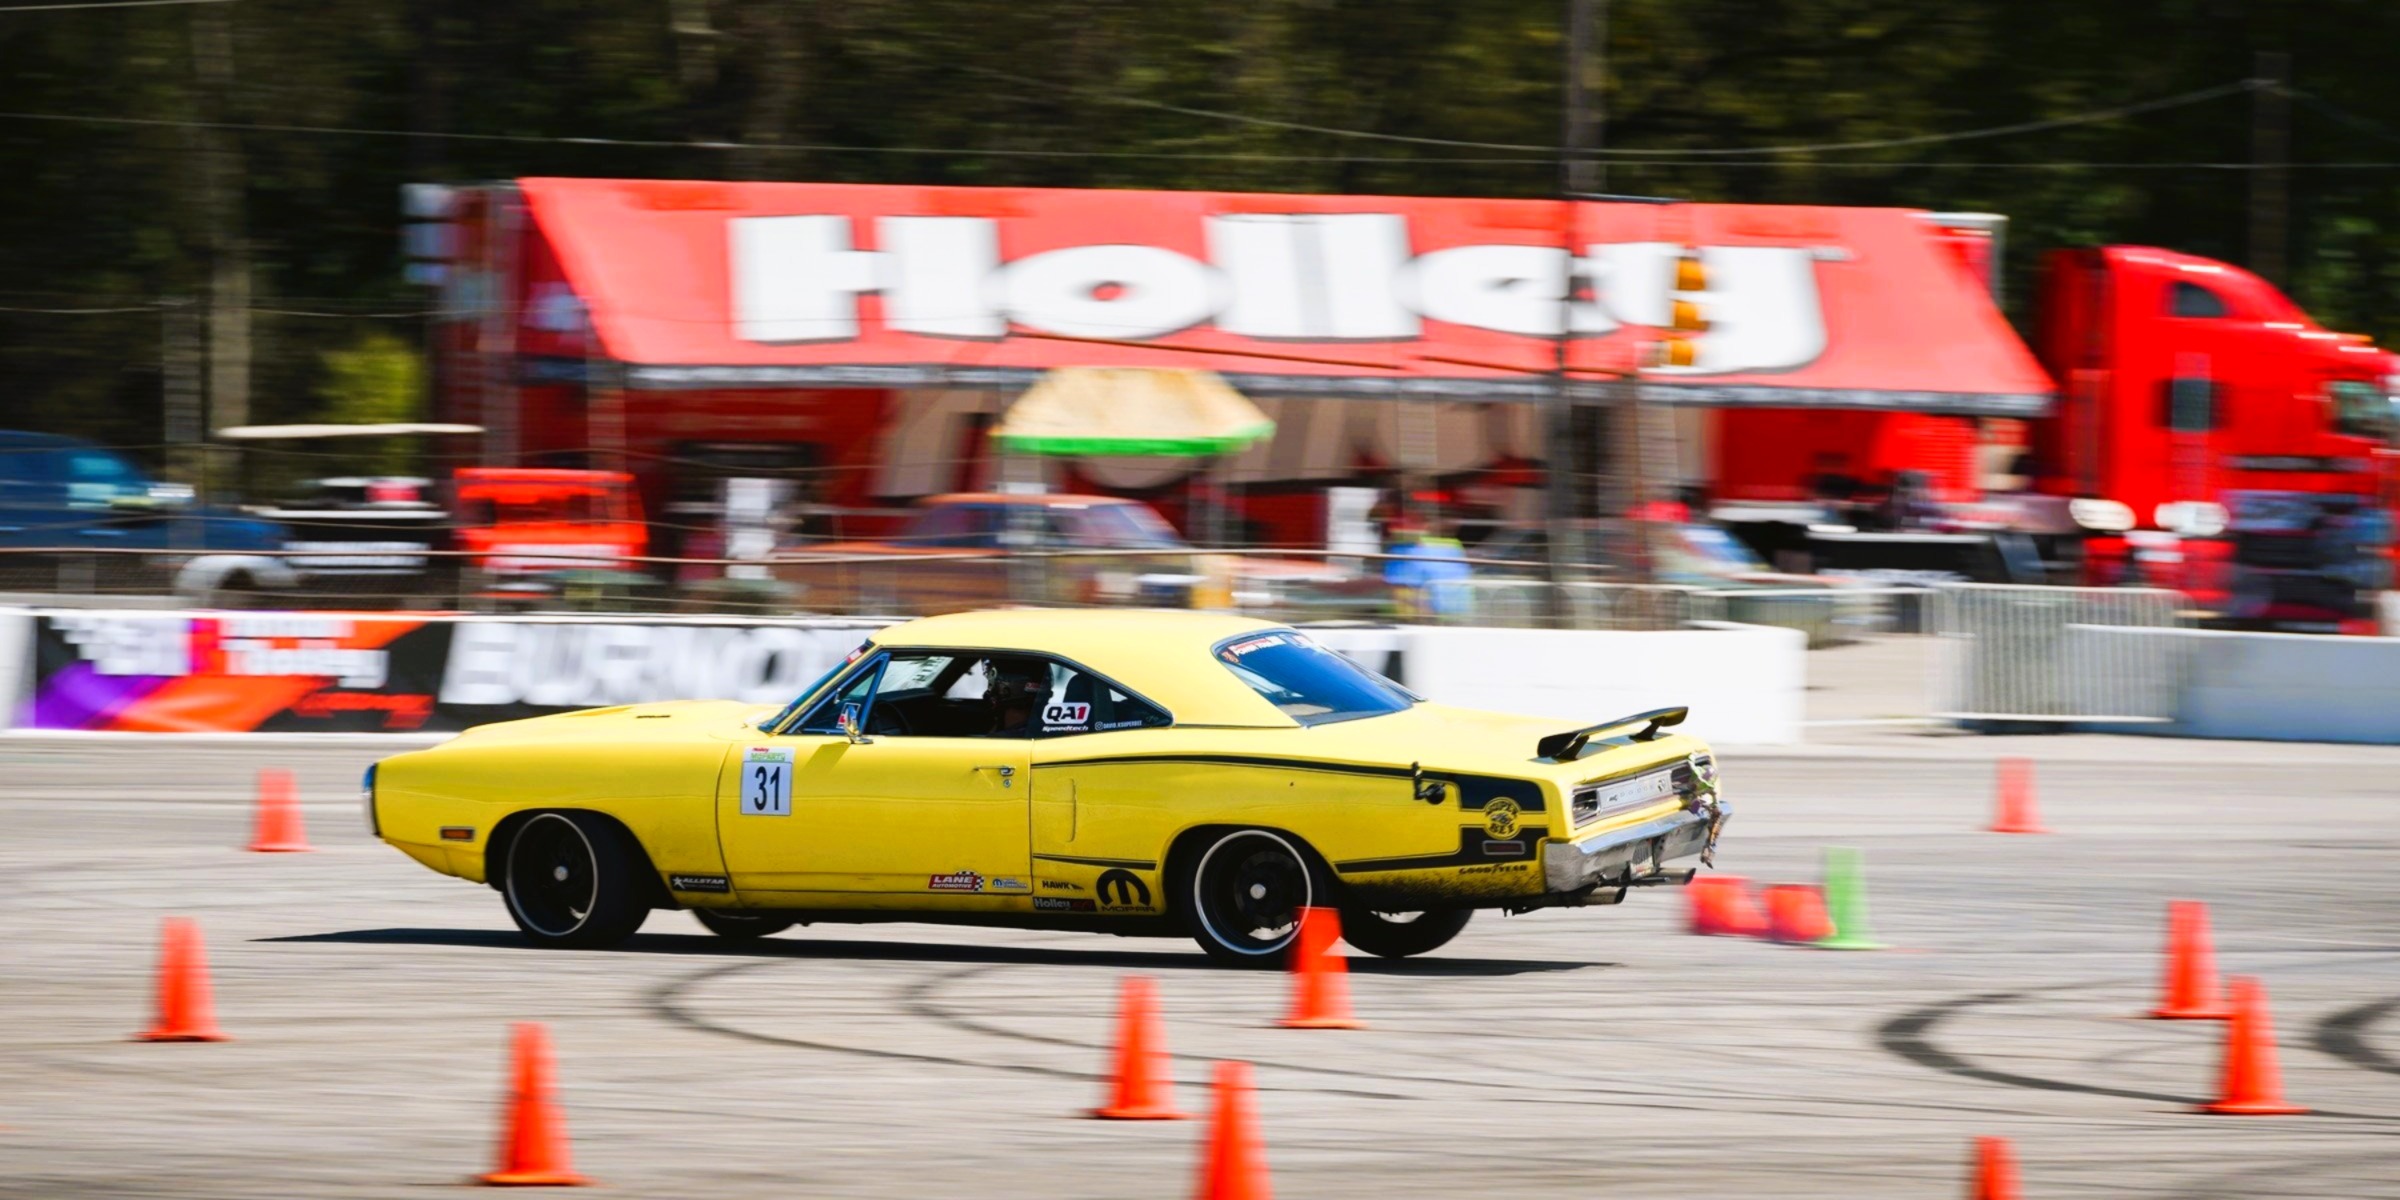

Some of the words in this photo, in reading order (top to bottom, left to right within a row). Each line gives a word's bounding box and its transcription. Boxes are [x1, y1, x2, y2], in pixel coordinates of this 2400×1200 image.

[729, 213, 1828, 374] Holley
[1046, 706, 1087, 721] QA1
[754, 766, 780, 811] 31
[1485, 800, 1519, 816] SUPER
[1490, 823, 1515, 835] BEE
[1459, 863, 1528, 875] GOODYEAR
[934, 876, 974, 884] LANE
[1042, 881, 1071, 889] HAWK
[1034, 898, 1071, 910] Holley
